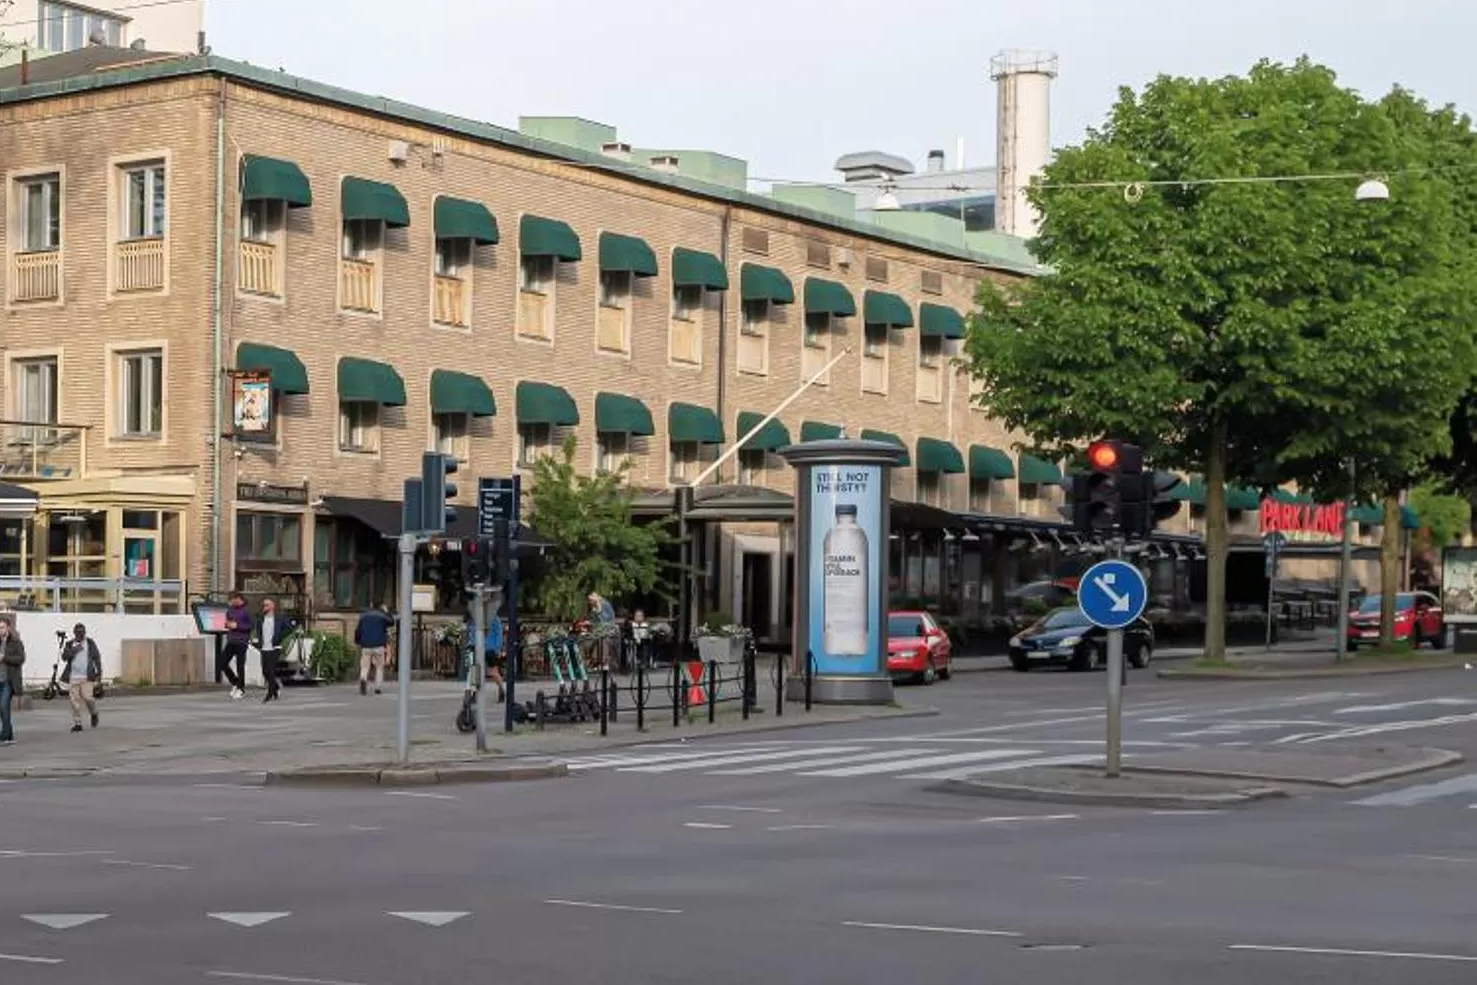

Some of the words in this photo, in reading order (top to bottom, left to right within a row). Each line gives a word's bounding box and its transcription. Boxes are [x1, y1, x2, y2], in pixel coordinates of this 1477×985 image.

[817, 472, 842, 482] STIL
[1260, 498, 1303, 532] PARK
[1304, 499, 1347, 538] LANE
